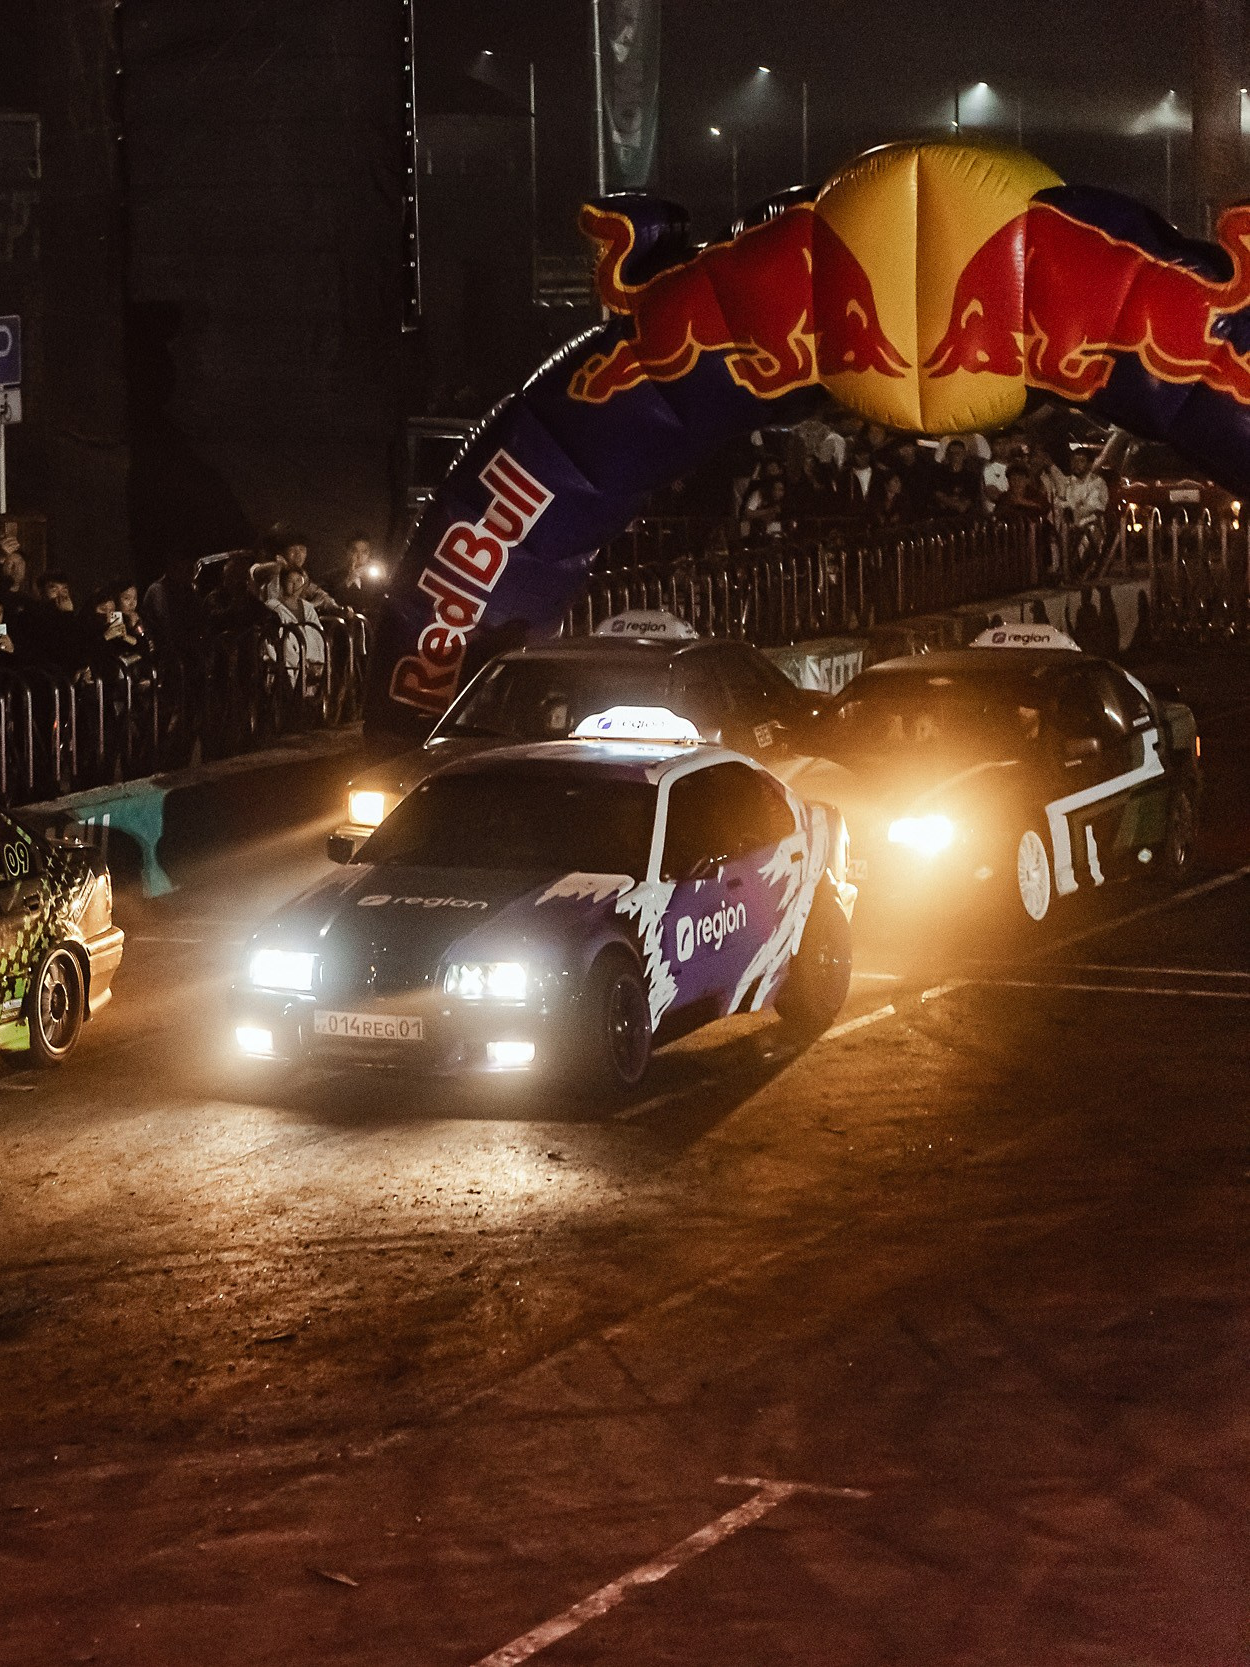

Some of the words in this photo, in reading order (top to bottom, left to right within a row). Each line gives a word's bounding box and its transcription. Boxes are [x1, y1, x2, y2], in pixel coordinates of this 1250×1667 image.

[626, 621, 667, 634] region
[1008, 633, 1050, 645] region
[3, 841, 30, 876] 09
[393, 896, 489, 910] region
[696, 900, 747, 951] region
